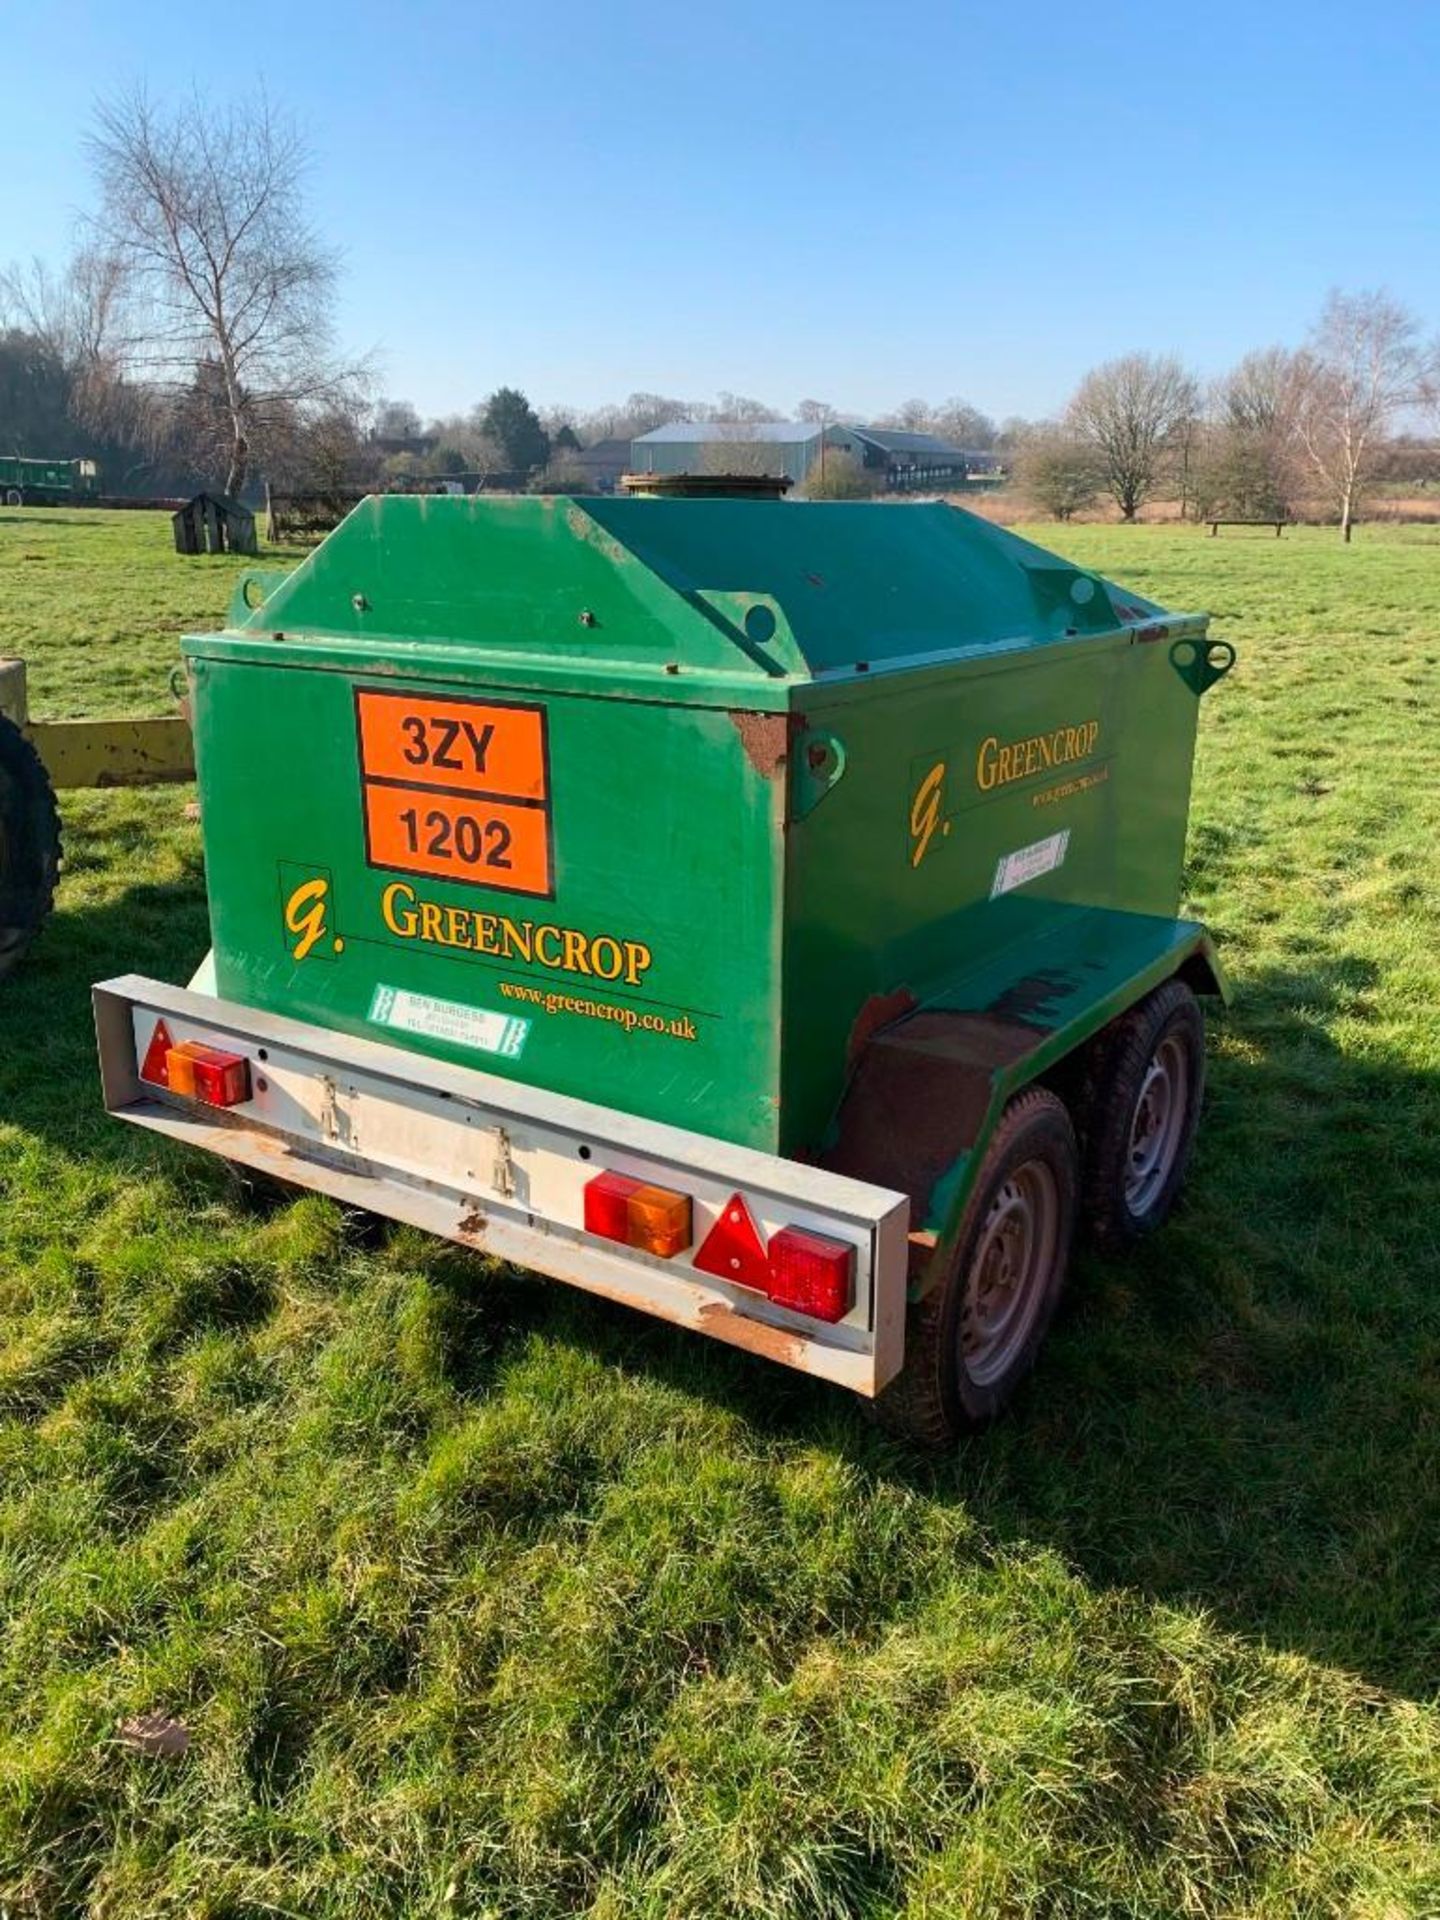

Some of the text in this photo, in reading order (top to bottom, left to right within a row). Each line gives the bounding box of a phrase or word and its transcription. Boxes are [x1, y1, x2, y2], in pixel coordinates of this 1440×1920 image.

[401, 716, 495, 774] 3ZY
[399, 808, 513, 870] 1202
[382, 881, 652, 986] GREENCROP
[499, 982, 697, 1040] www.greencrop.co.uk
